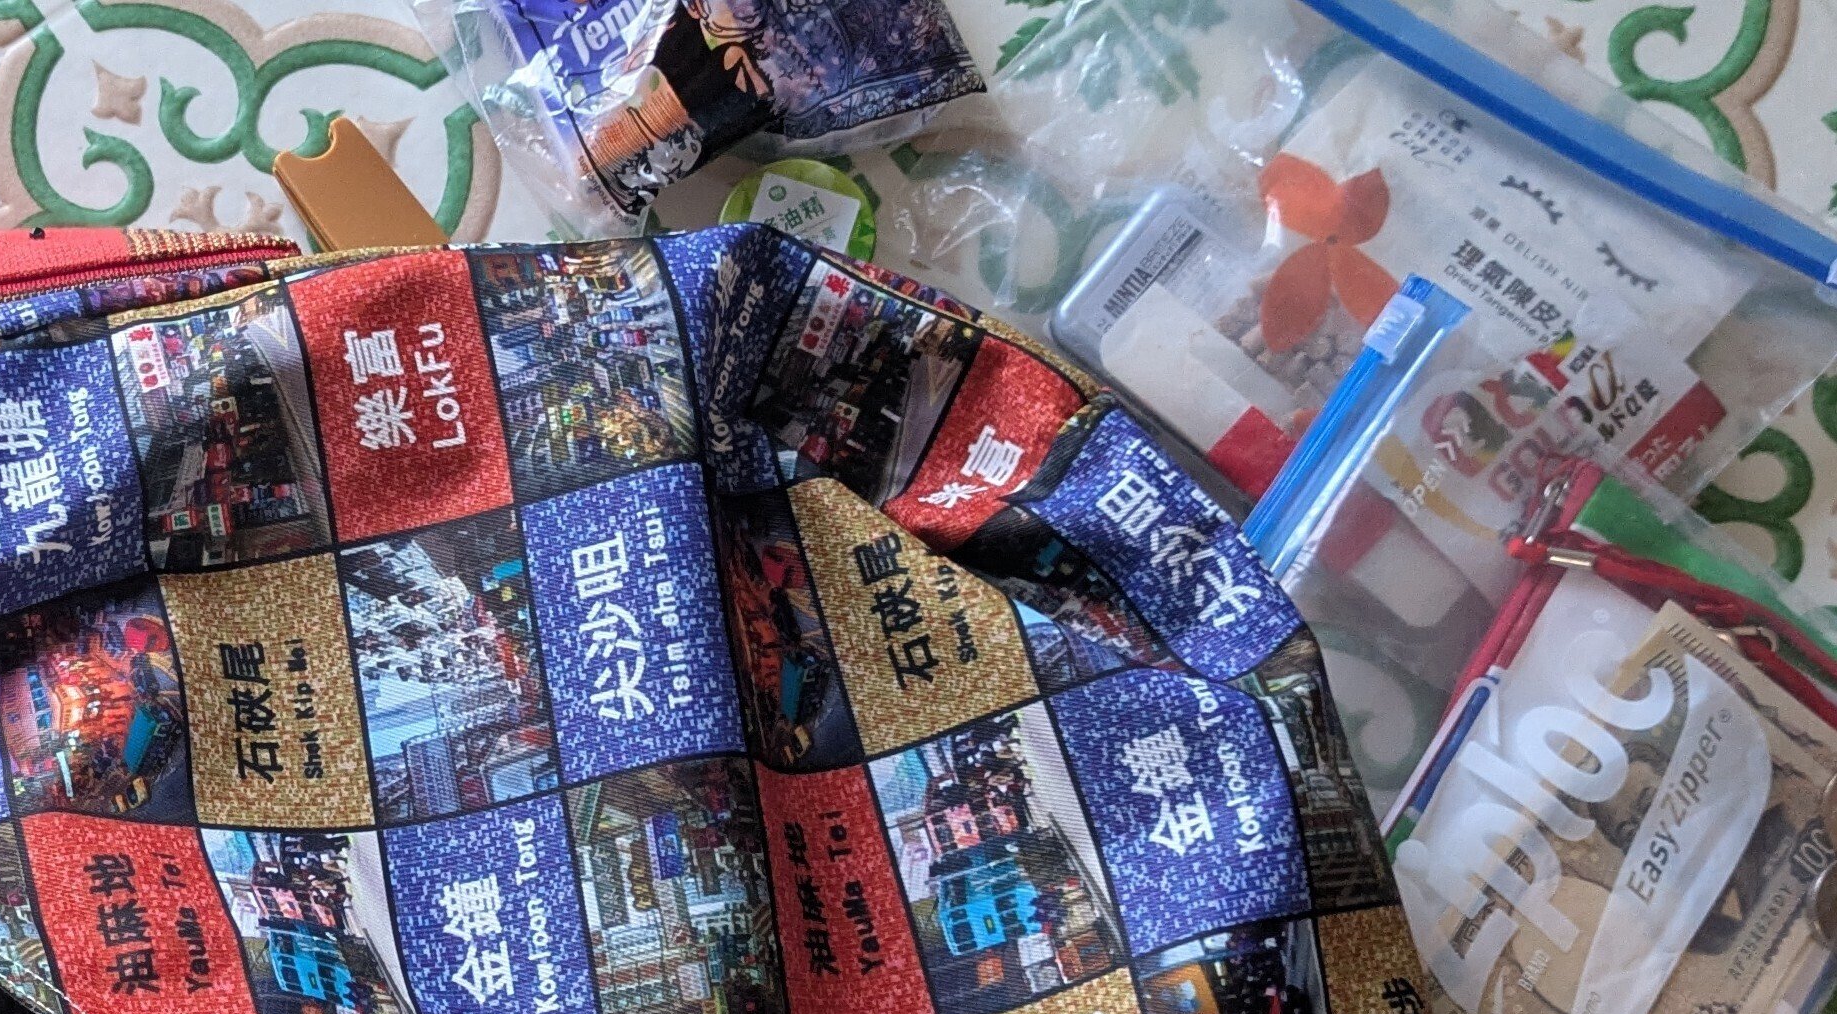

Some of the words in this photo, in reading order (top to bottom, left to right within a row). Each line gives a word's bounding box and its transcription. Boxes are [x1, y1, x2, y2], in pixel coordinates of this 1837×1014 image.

[578, 155, 610, 207] Productions
[1103, 267, 1153, 319] MINTIA
[1444, 264, 1480, 293] Dried
[1479, 290, 1538, 336] Tangerine
[1451, 239, 1574, 332] 理氣陳皮
[68, 387, 89, 446] Tong
[344, 326, 418, 451] 樂富
[416, 321, 467, 451] LokFu
[1403, 459, 1446, 514] OPEN
[642, 505, 668, 568] Tsui
[1095, 470, 1262, 627] 尖沙咀
[568, 530, 657, 724] 尖沙咀
[292, 681, 316, 720] Kip
[665, 640, 691, 712] Tsim
[1121, 723, 1214, 857] 金鐘
[514, 818, 539, 887] Tong
[1627, 825, 1681, 905] Easy
[85, 851, 162, 996] 油麻地
[439, 873, 514, 1005] 金鐘
[782, 820, 841, 979] 油麻地
[527, 898, 560, 1014] Kowloon
[1518, 948, 1551, 993] BRAND
